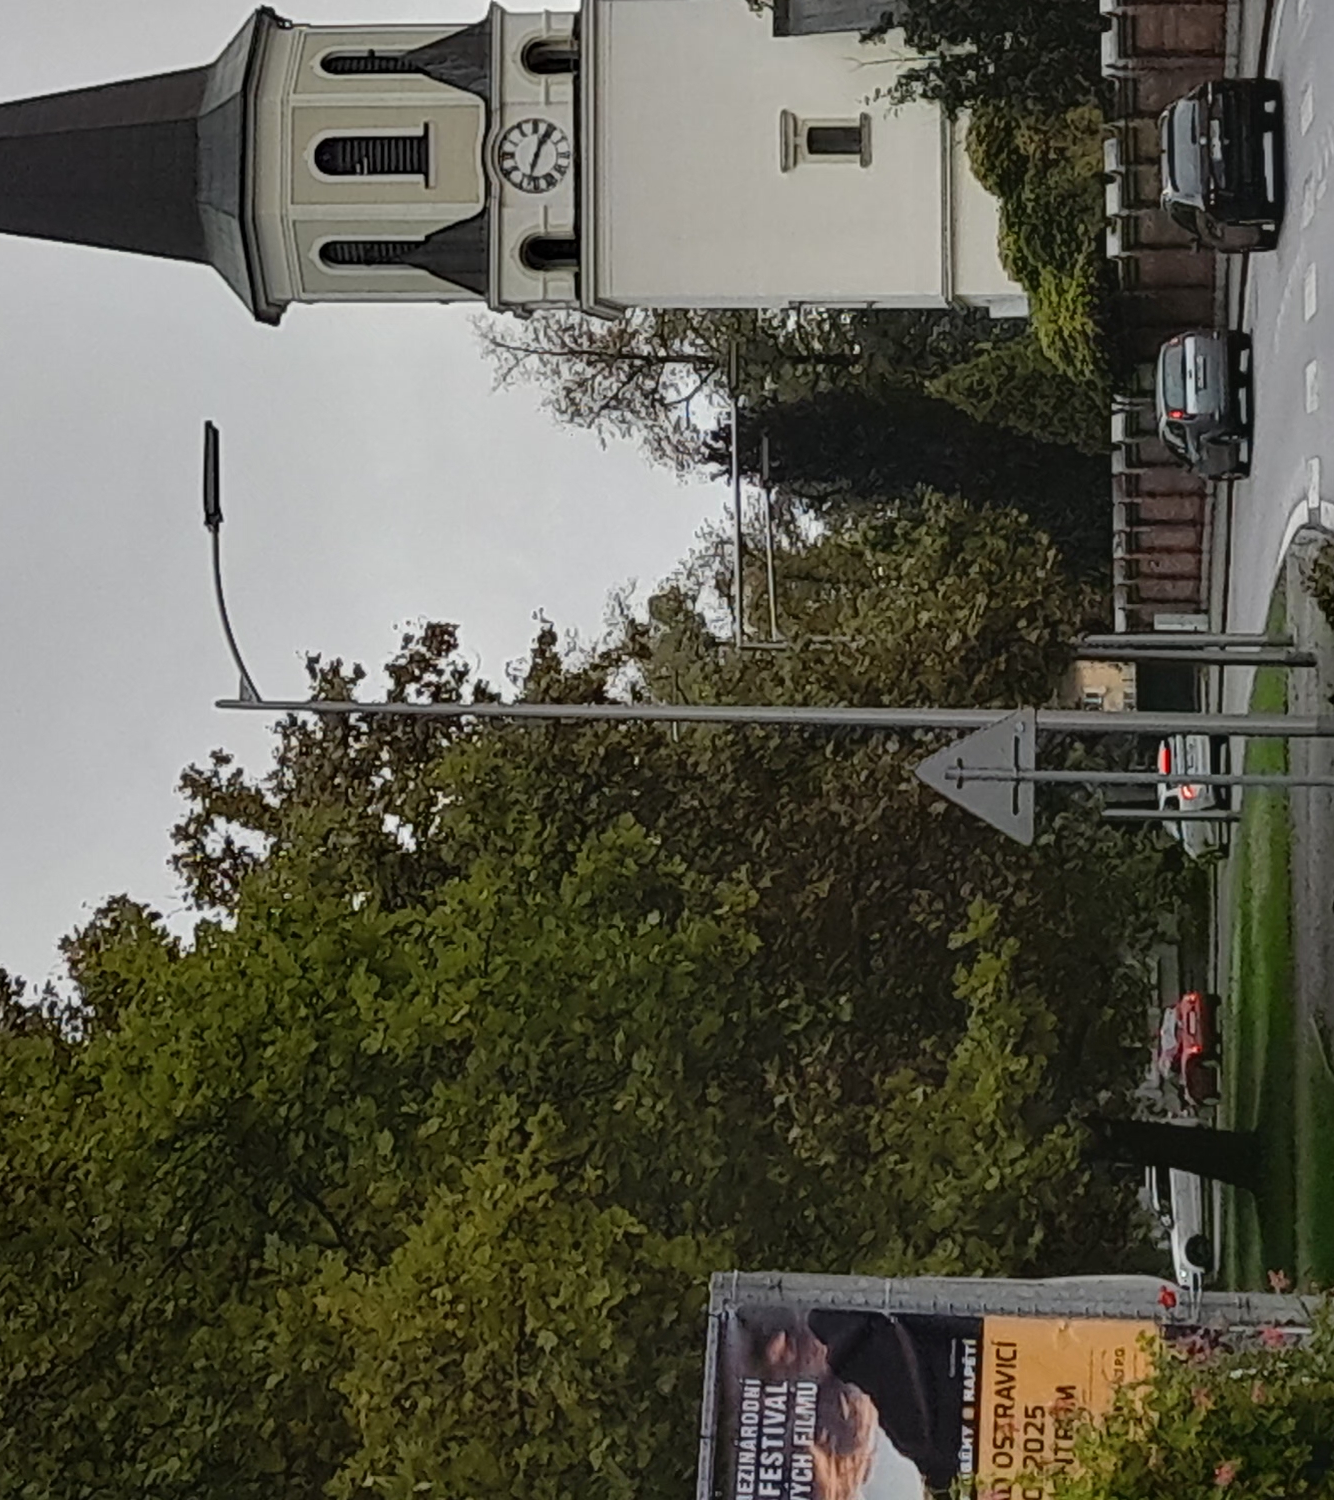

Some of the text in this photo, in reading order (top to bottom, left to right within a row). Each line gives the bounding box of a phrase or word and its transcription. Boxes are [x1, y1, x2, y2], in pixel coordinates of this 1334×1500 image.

[758, 1381, 788, 1496] FESTIVAL
[790, 1382, 818, 1446] FILMŮ
[991, 1341, 1017, 1469] OSTRAVICÍ
[1022, 1405, 1045, 1472] 2025
